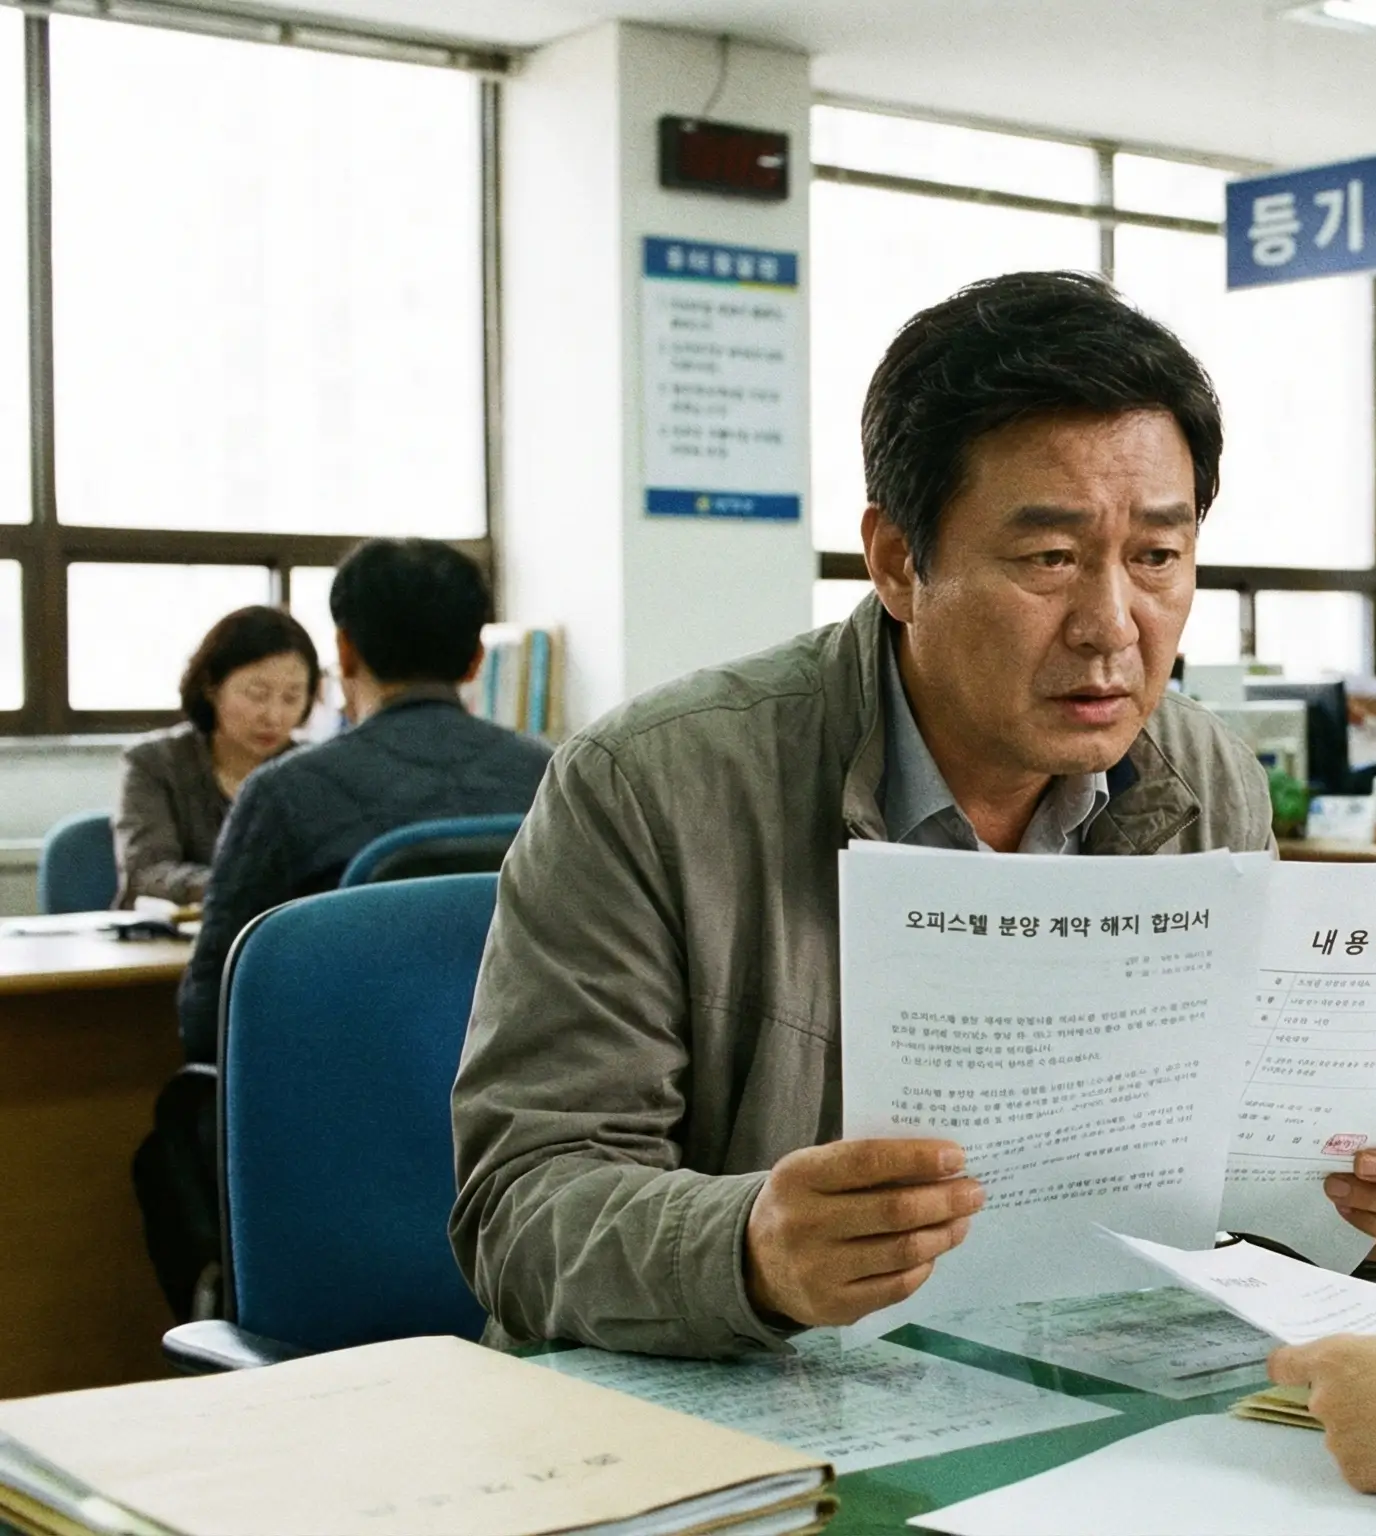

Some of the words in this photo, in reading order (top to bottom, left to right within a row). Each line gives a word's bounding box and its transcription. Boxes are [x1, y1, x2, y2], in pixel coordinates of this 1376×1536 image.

[998, 915, 1040, 937] 분양
[1049, 915, 1091, 938] 계약
[1100, 914, 1140, 936] 해지
[1151, 909, 1210, 934] 합의서
